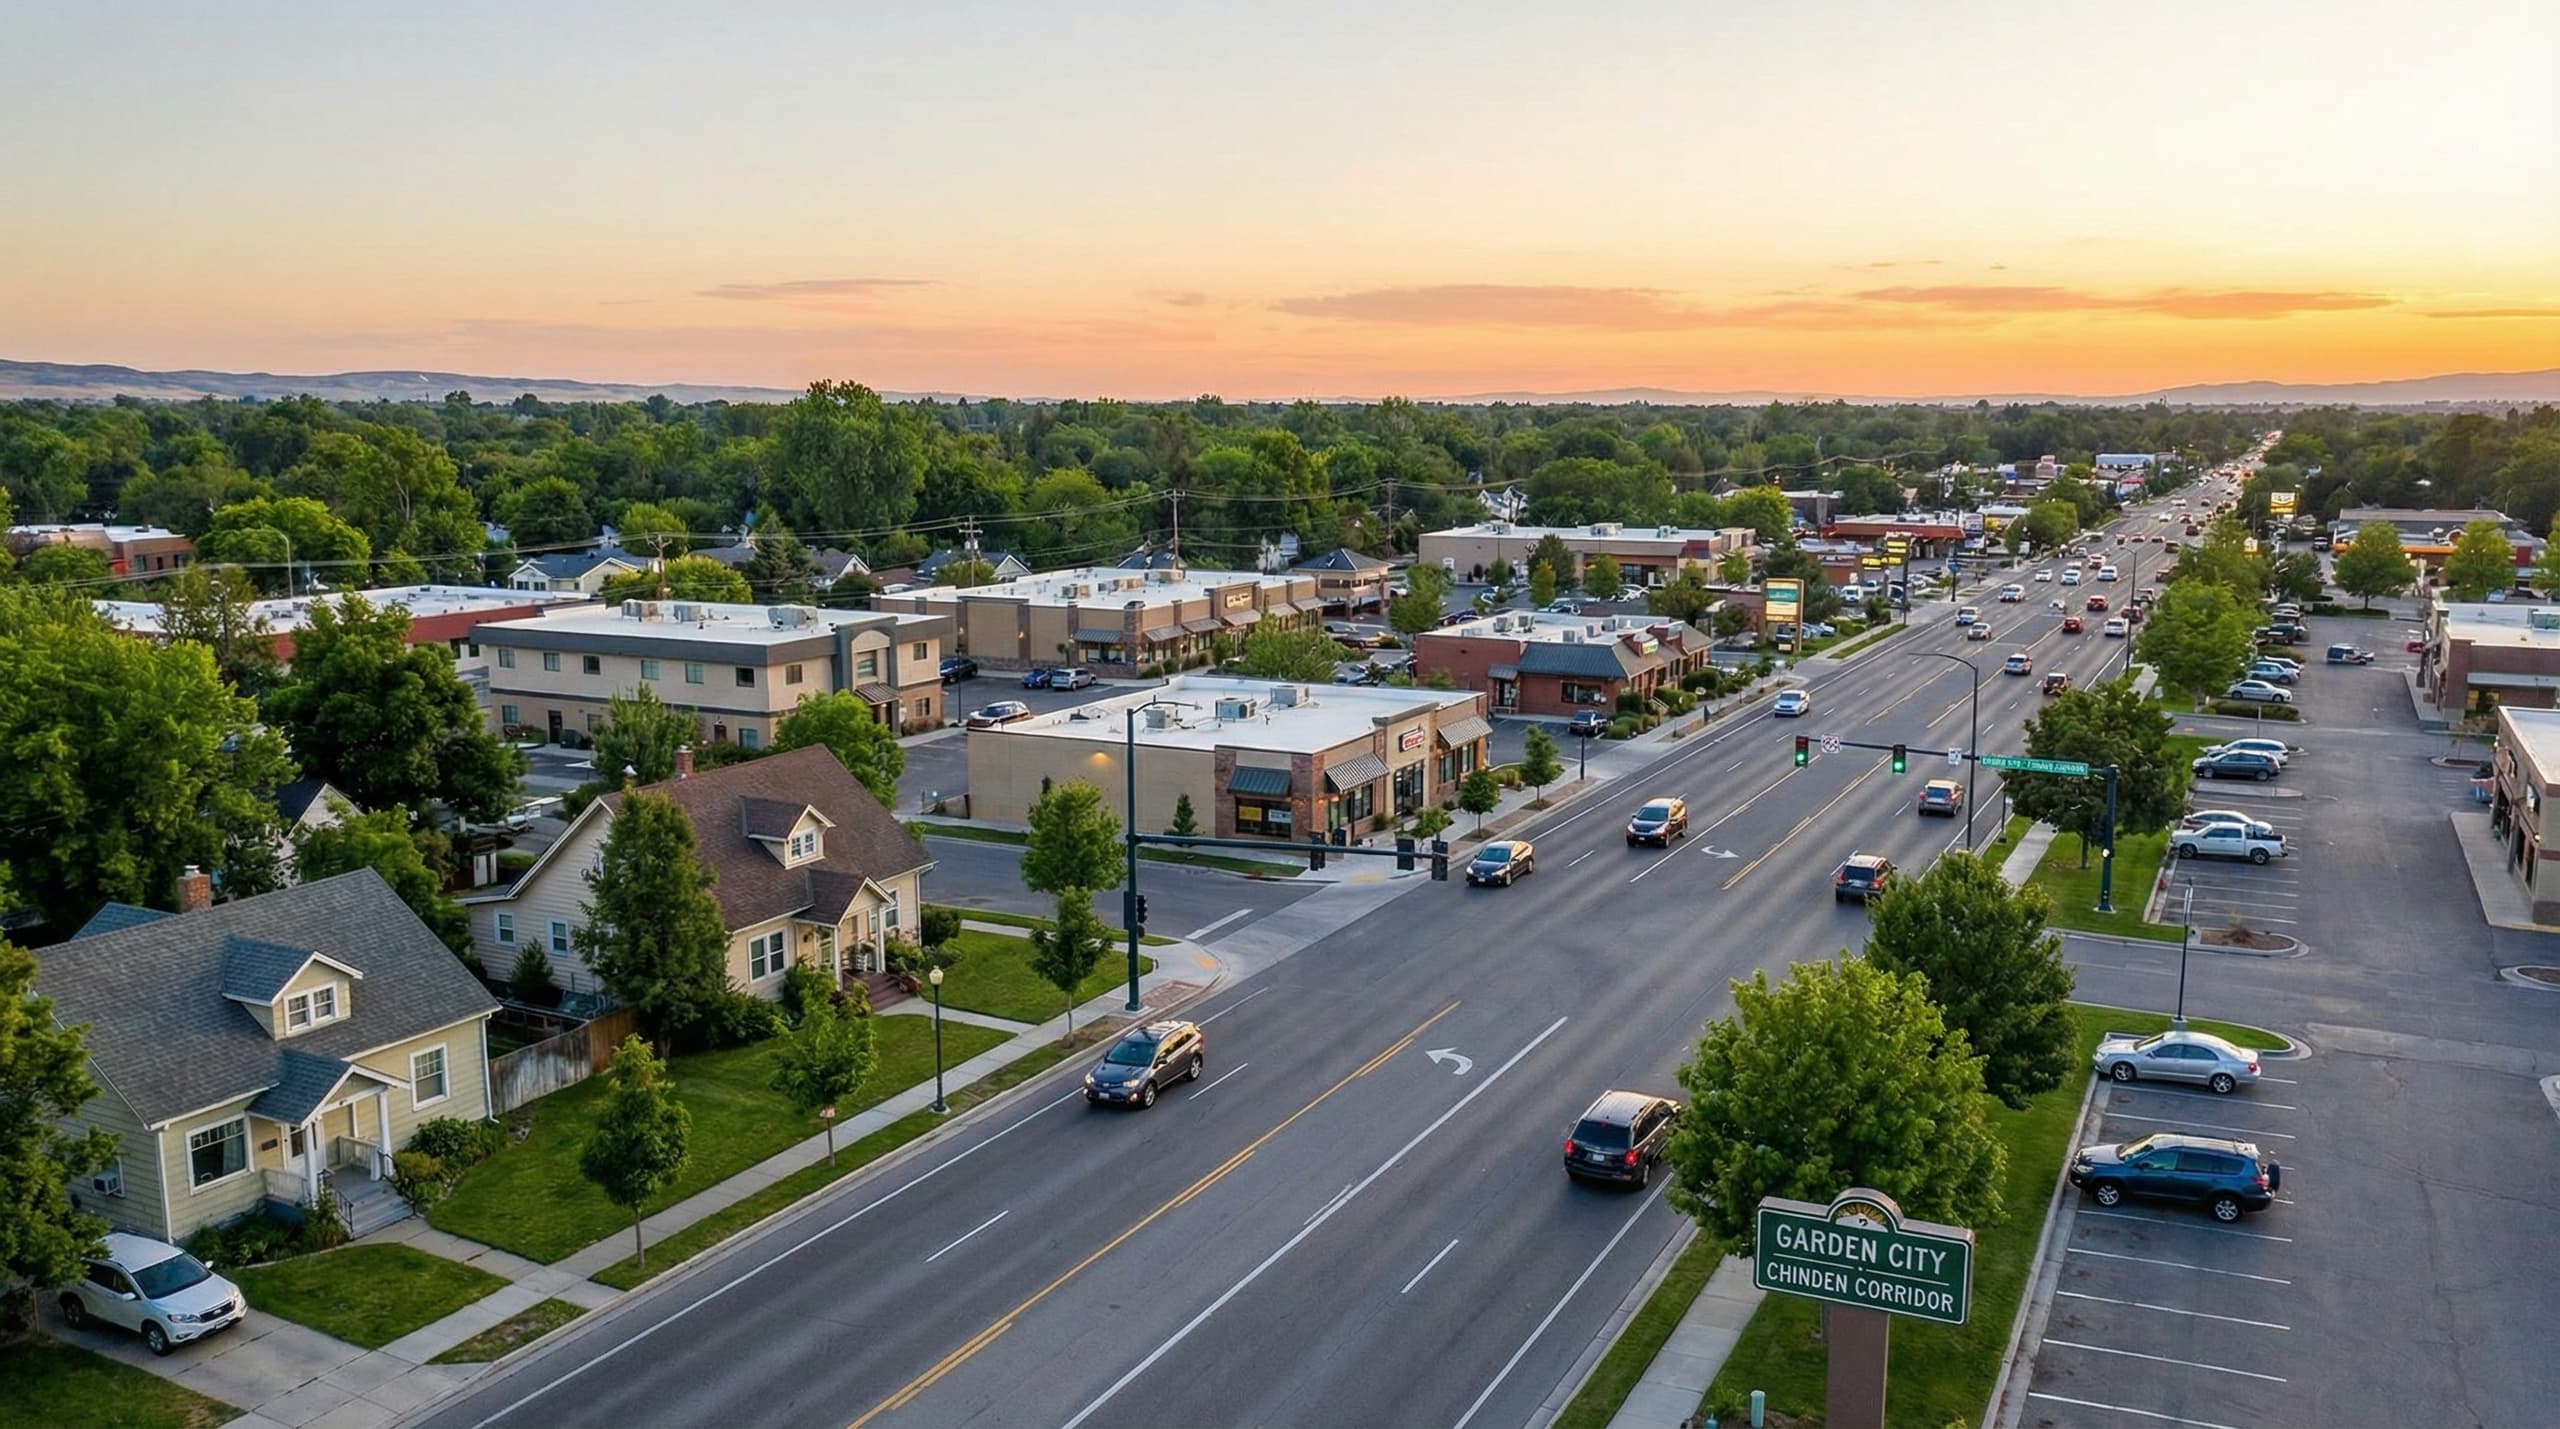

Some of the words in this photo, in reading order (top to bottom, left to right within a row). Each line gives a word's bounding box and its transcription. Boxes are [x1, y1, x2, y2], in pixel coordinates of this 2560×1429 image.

[1776, 1223, 1877, 1264] GARDEN
[1888, 1243, 1947, 1275] CITY
[1766, 1262, 1848, 1294] CHINDEN
[1855, 1278, 1954, 1313] CORRIDOR
